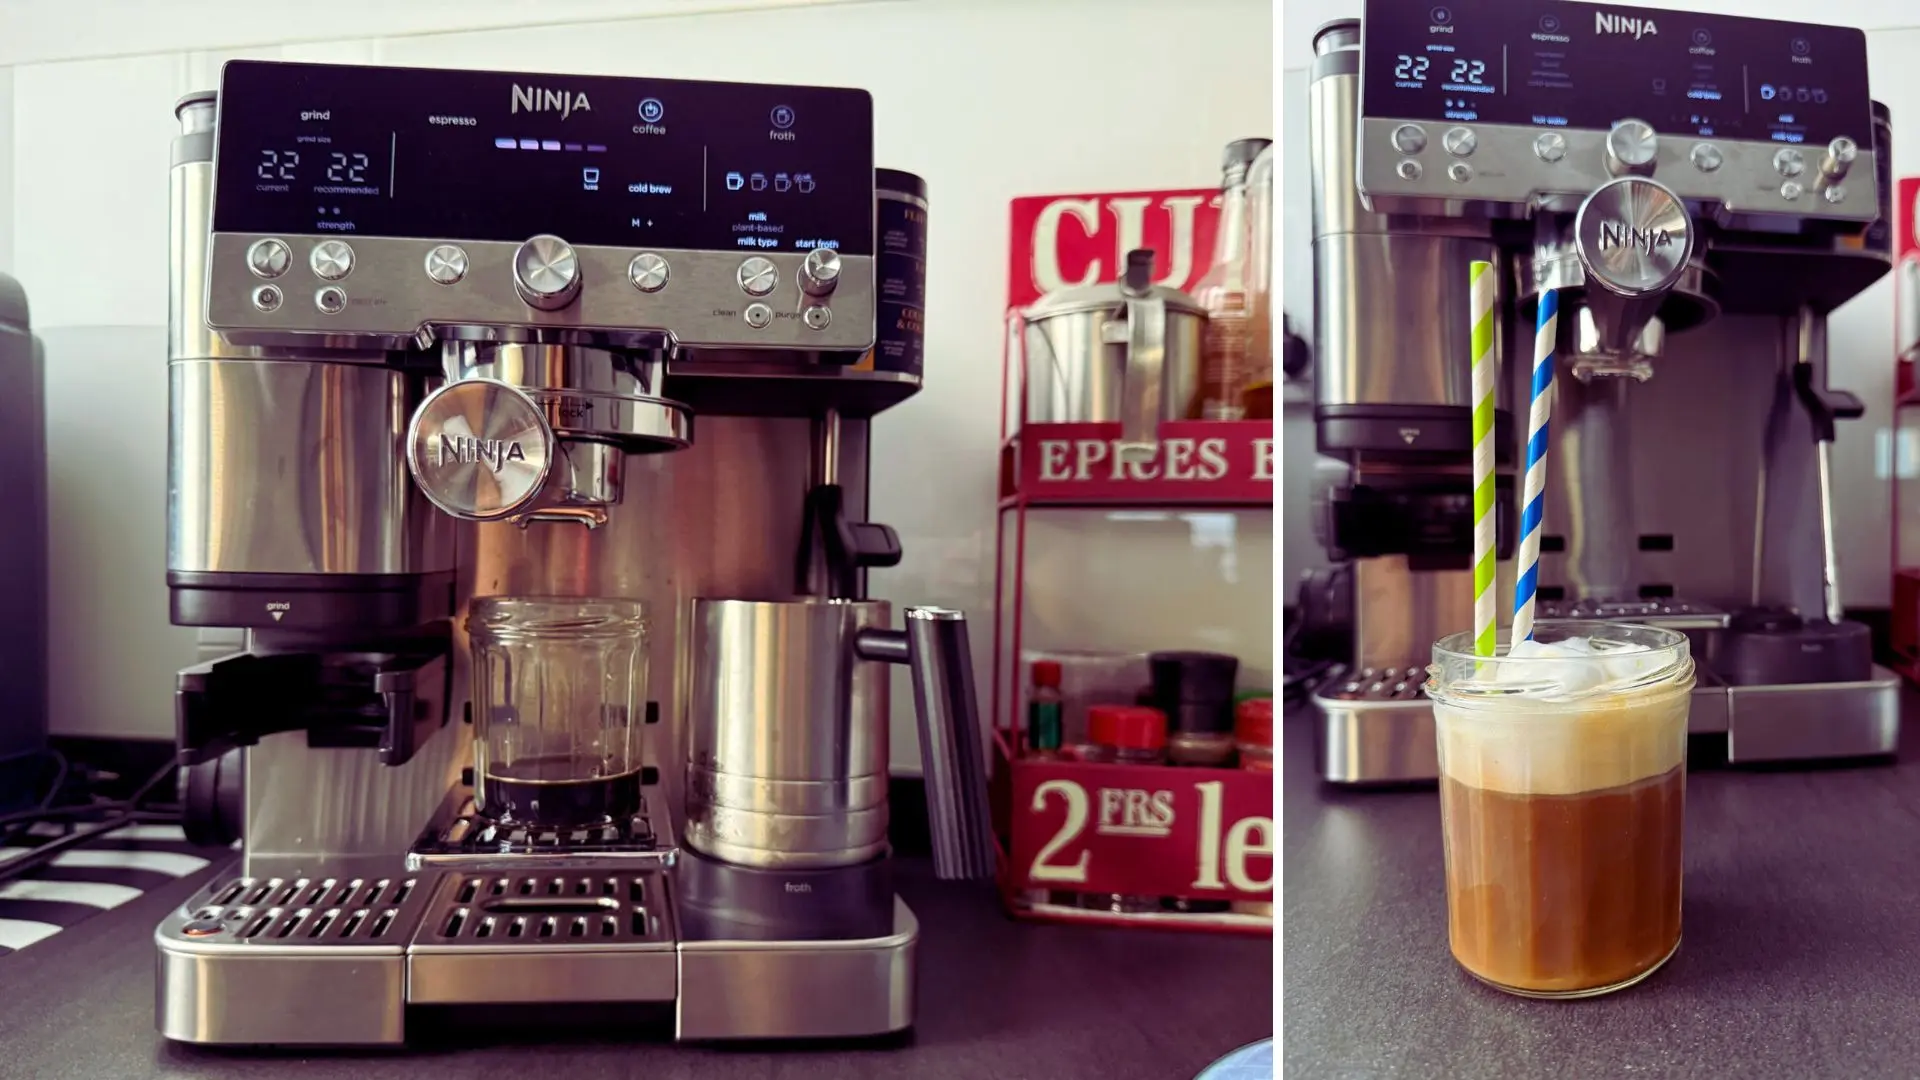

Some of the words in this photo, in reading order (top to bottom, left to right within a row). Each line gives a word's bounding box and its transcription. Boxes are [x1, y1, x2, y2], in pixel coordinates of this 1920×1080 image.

[1429, 25, 1454, 34] grind
[1595, 11, 1657, 41] NINJA
[1395, 54, 1430, 80] 22
[1451, 59, 1486, 84] 22
[511, 82, 592, 121] NINJA
[300, 109, 331, 121] grind
[428, 114, 478, 127] espresso
[632, 124, 667, 135] coffee
[769, 130, 796, 142] froth
[257, 150, 300, 180] 22
[327, 152, 369, 183] 22
[256, 183, 290, 193] current
[313, 185, 380, 195] recommended
[628, 182, 648, 194] cold
[649, 183, 673, 195] brew
[748, 211, 767, 221] milk
[316, 220, 356, 231] strength
[631, 217, 640, 228] M
[732, 223, 784, 234] plant-based
[737, 236, 756, 247] milk
[757, 237, 779, 249] type
[795, 238, 816, 249] start
[817, 238, 840, 249] froth
[1598, 219, 1673, 256] NINJA
[1031, 195, 1223, 296] CU
[712, 308, 737, 318] clean
[438, 433, 526, 473] NINJA
[266, 602, 291, 611] grind
[1029, 779, 1091, 882] 2
[1097, 787, 1175, 828] FRS
[784, 881, 812, 893] froth
